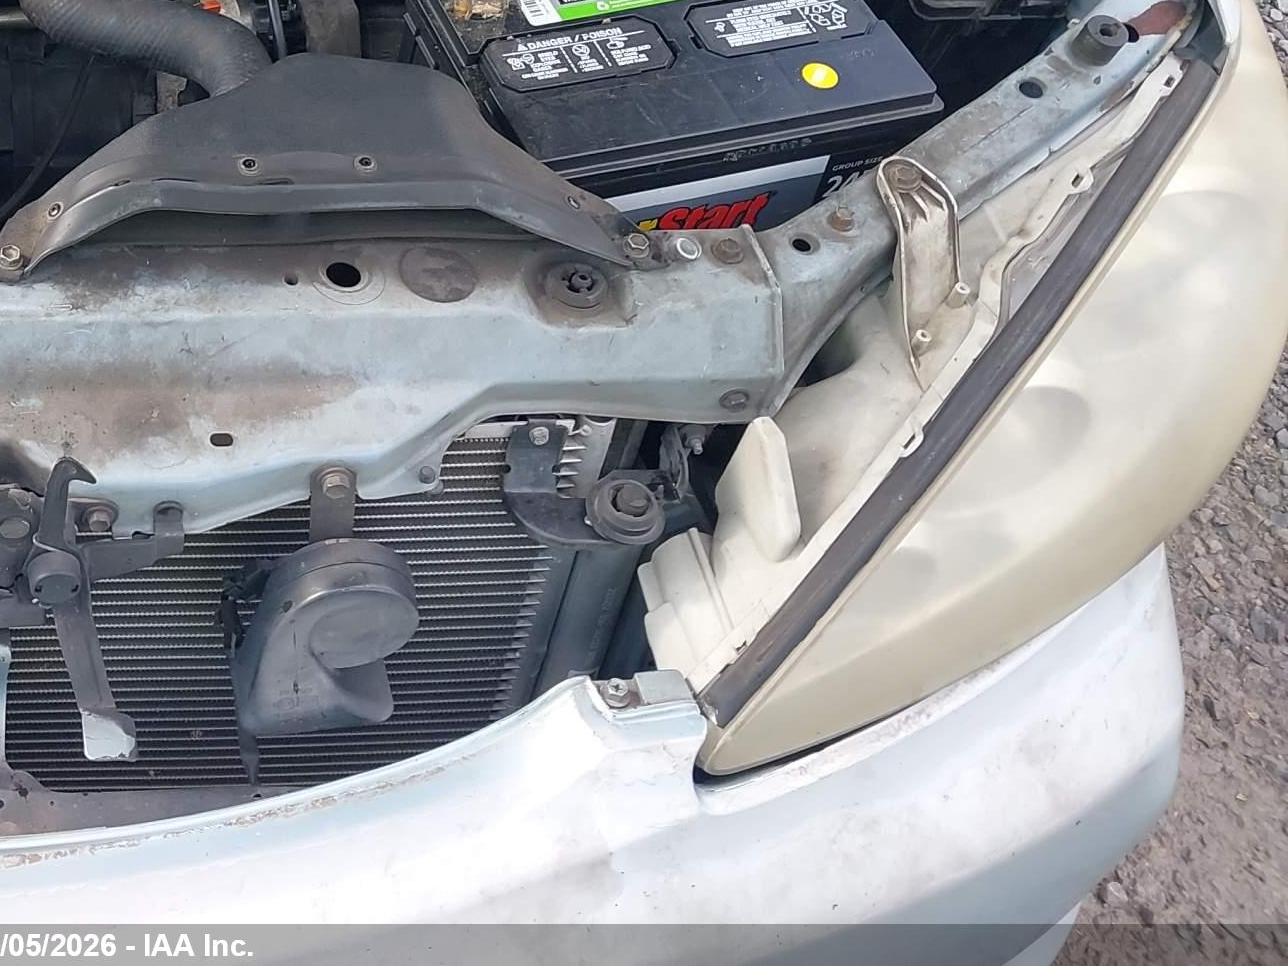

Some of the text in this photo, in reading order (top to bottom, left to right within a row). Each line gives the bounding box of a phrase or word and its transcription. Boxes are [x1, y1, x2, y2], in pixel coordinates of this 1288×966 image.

[527, 36, 572, 50] DANGER
[582, 27, 623, 40] POISON
[832, 160, 863, 172] GROUP
